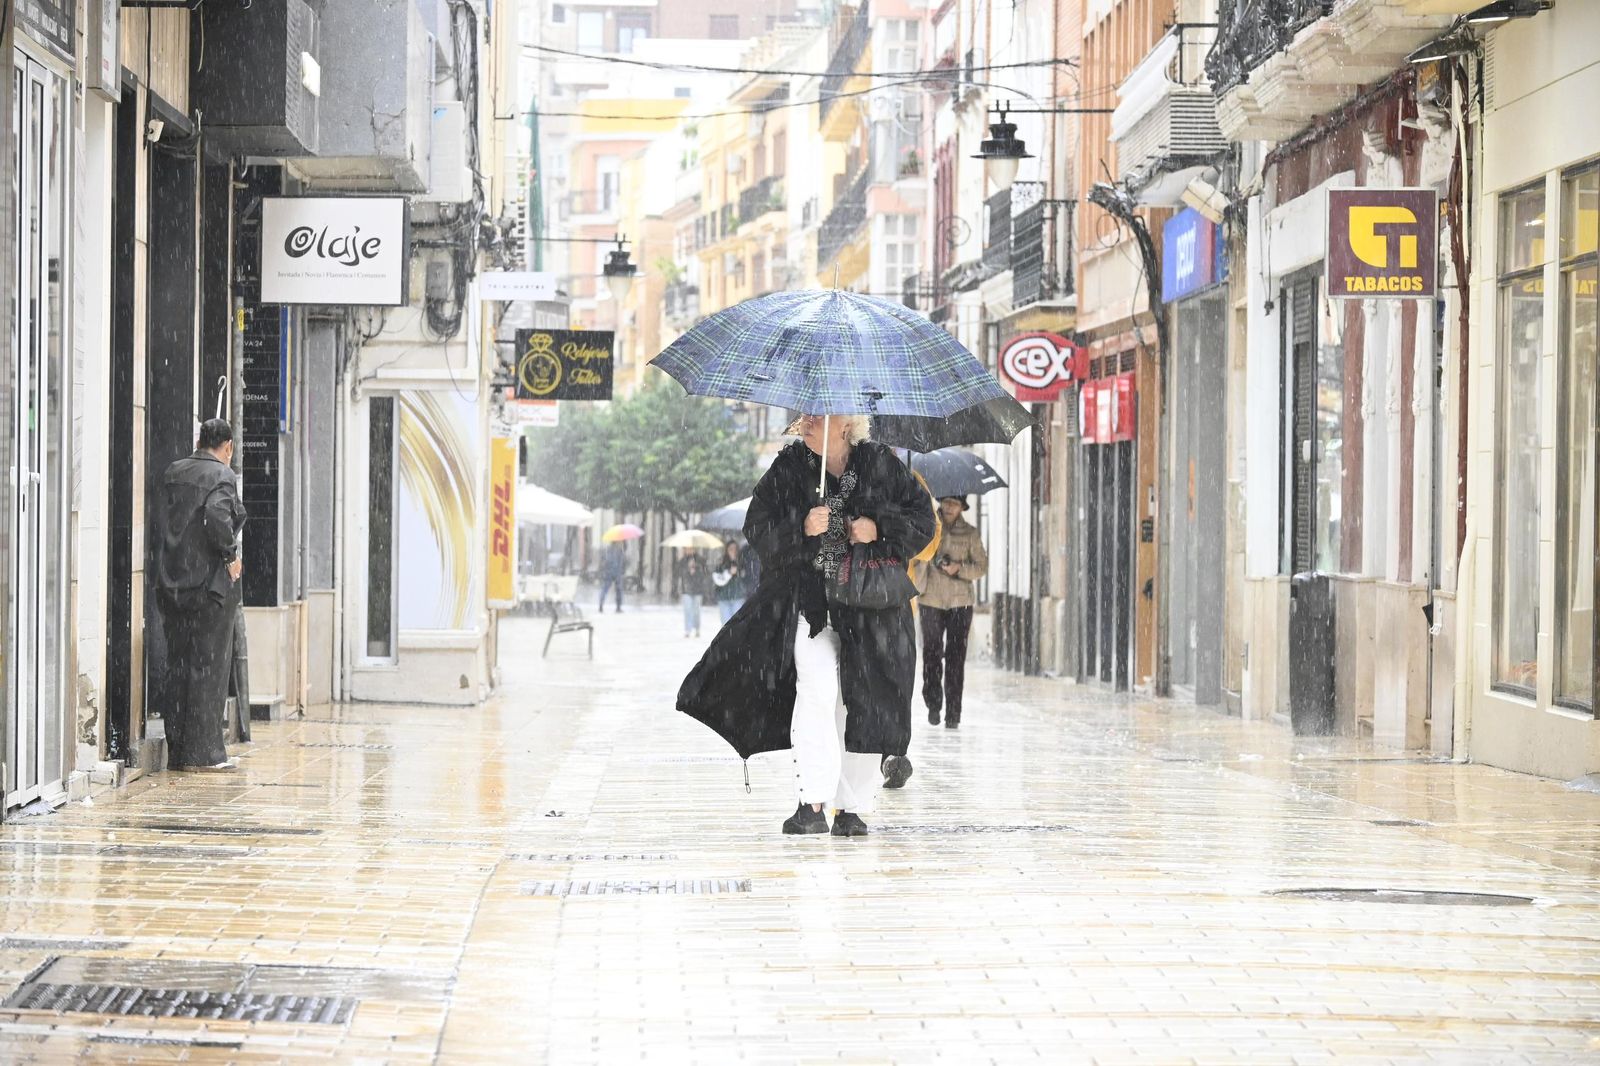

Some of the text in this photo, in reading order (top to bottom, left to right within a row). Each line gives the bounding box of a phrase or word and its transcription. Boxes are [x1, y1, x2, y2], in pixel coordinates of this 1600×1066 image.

[284, 225, 381, 267] Olaje
[1344, 276, 1423, 292] TABACOS
[492, 480, 511, 557] DHL
